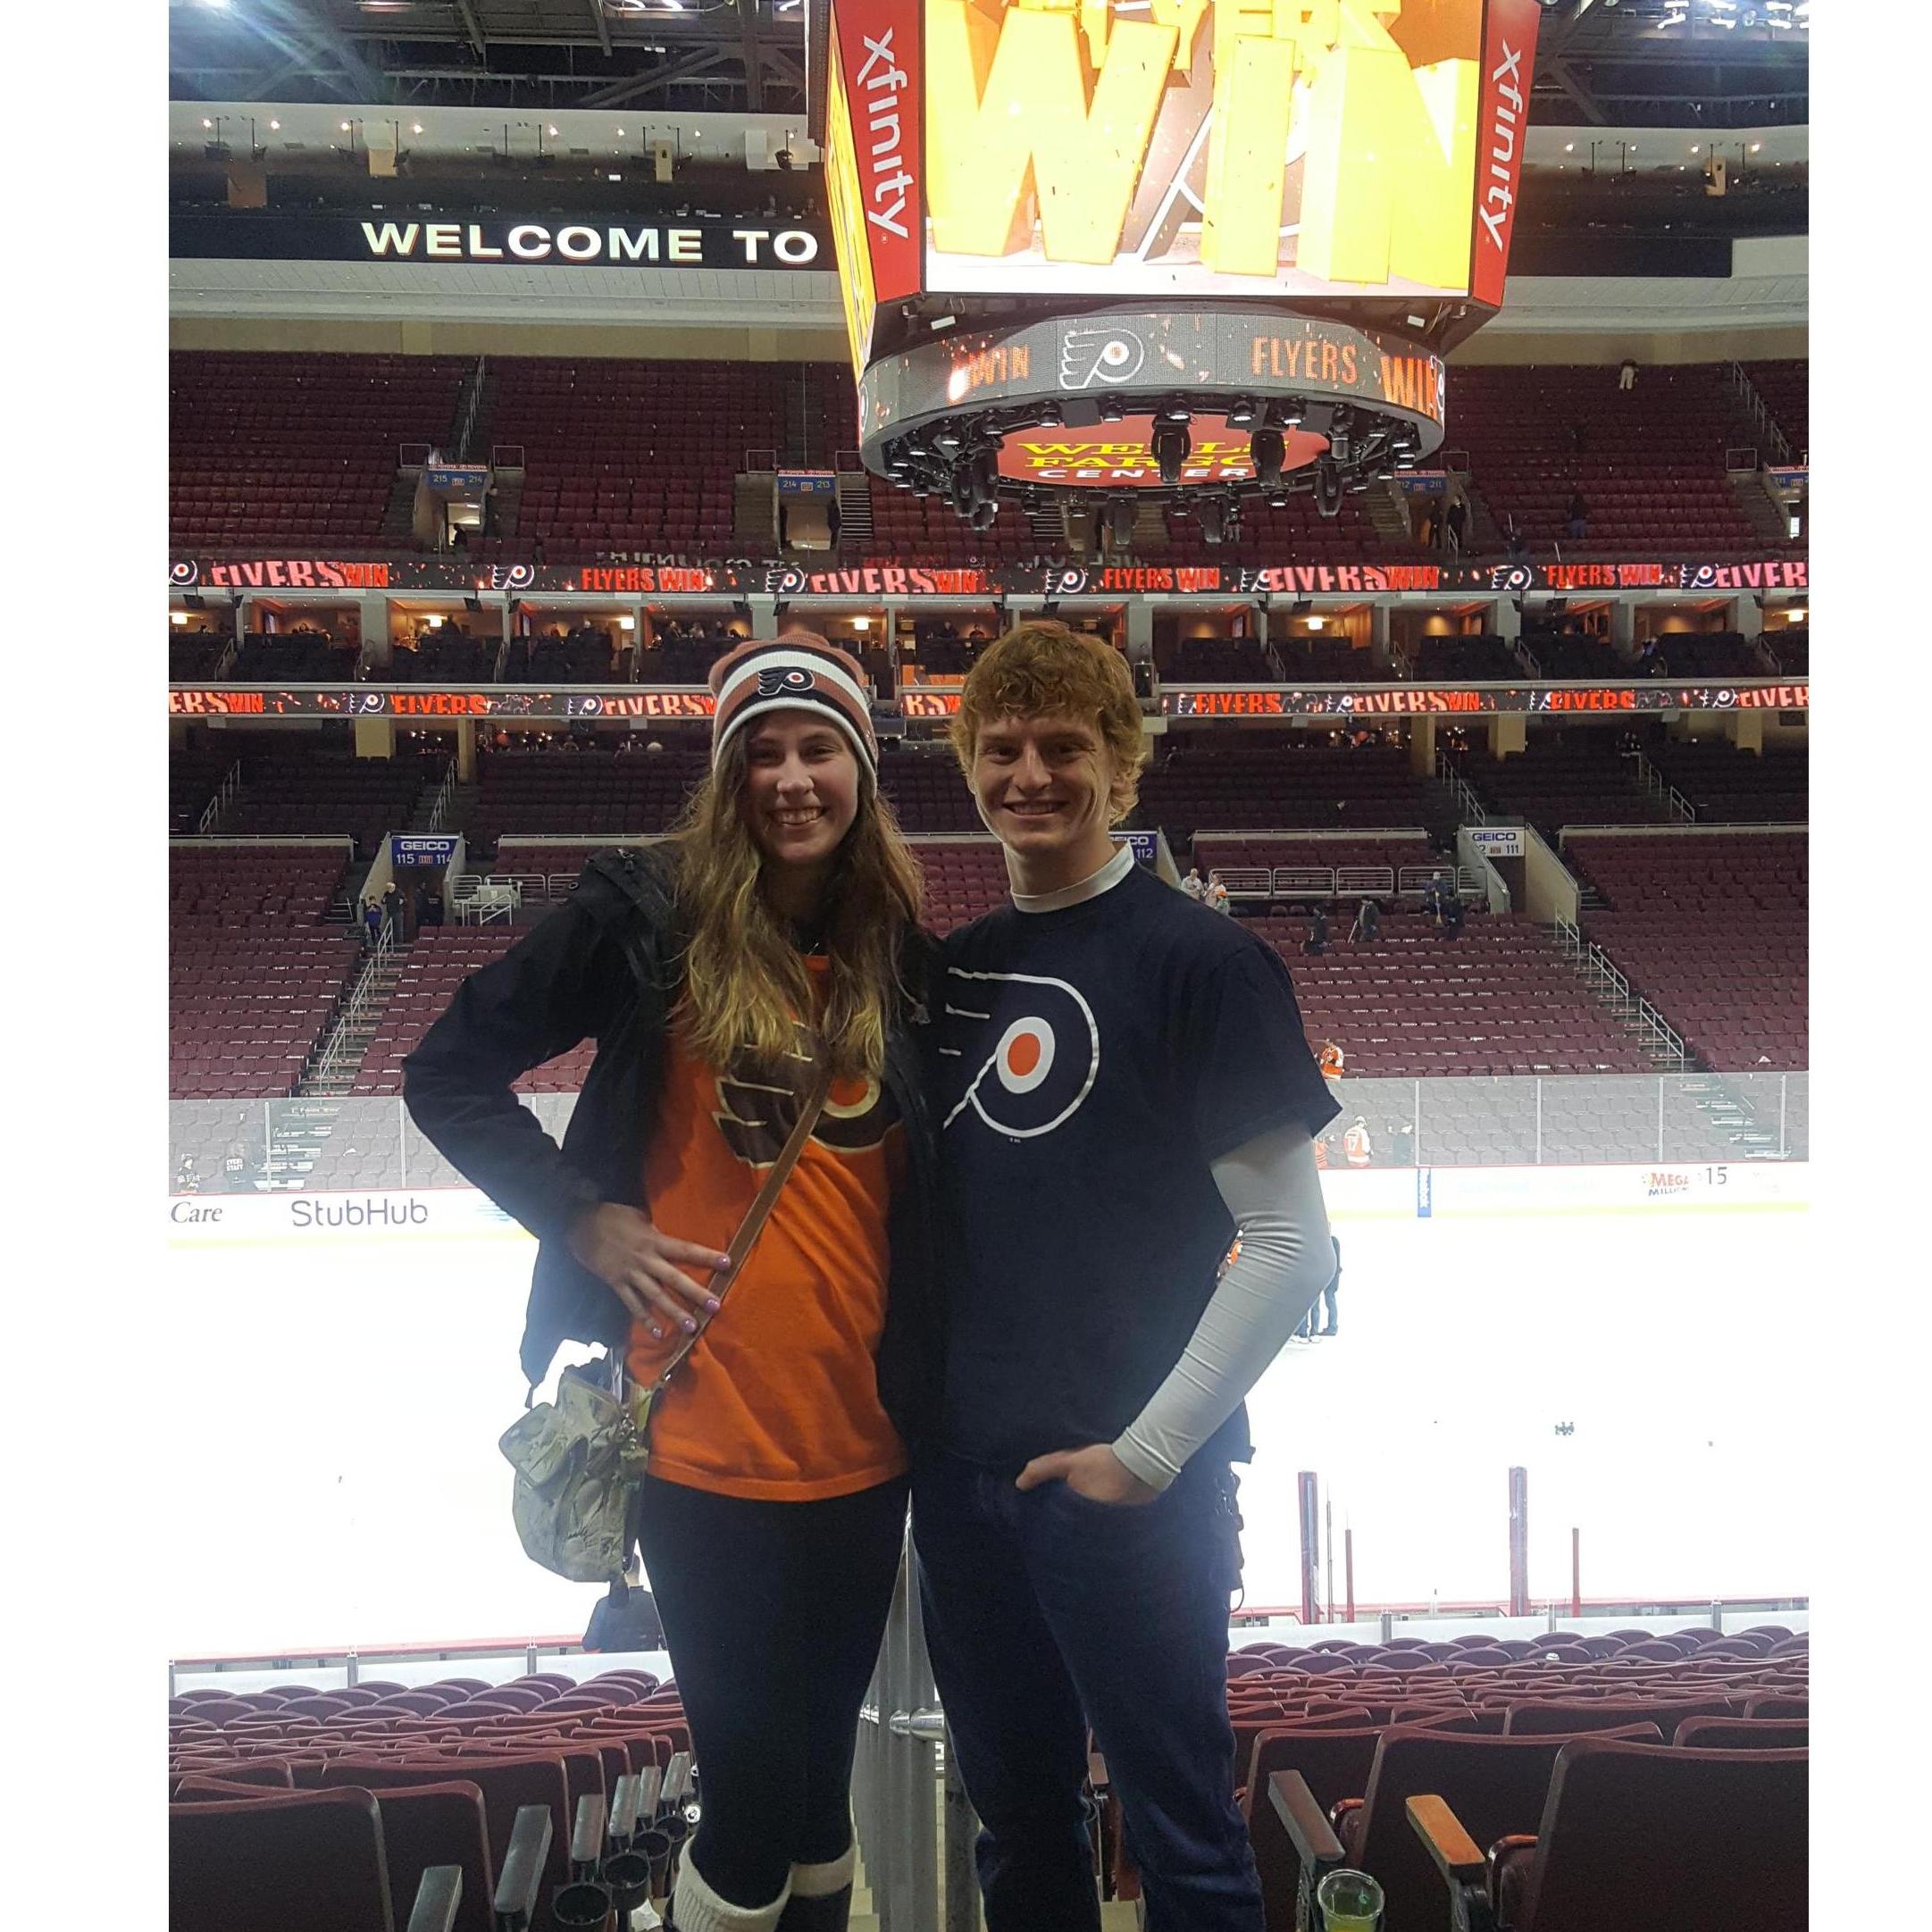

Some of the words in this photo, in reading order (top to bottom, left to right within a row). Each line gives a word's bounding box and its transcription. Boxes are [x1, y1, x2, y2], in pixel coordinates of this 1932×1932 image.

[857, 27, 914, 238] xfinity
[926, 0, 1478, 289] WIN
[1480, 38, 1523, 252] xfinity
[361, 222, 703, 263] WELCOME
[733, 230, 819, 265] TO
[1251, 336, 1358, 384] FLYERS
[1017, 442, 1289, 455] WEL
[581, 567, 653, 590] FLYERS
[657, 566, 707, 591] WIN
[1104, 568, 1172, 590] FLYERS
[1175, 567, 1220, 590] WIN
[1546, 565, 1615, 589] FLYERS
[1618, 564, 1662, 587] WIN
[400, 841, 450, 850] GEICO
[1472, 832, 1517, 841] GEICO
[397, 854, 414, 864] 115
[1135, 848, 1153, 858] 112
[1506, 845, 1519, 854] 111
[1705, 1166, 1727, 1185] 15
[171, 1200, 223, 1224] Care
[290, 1198, 429, 1227] StubHub
